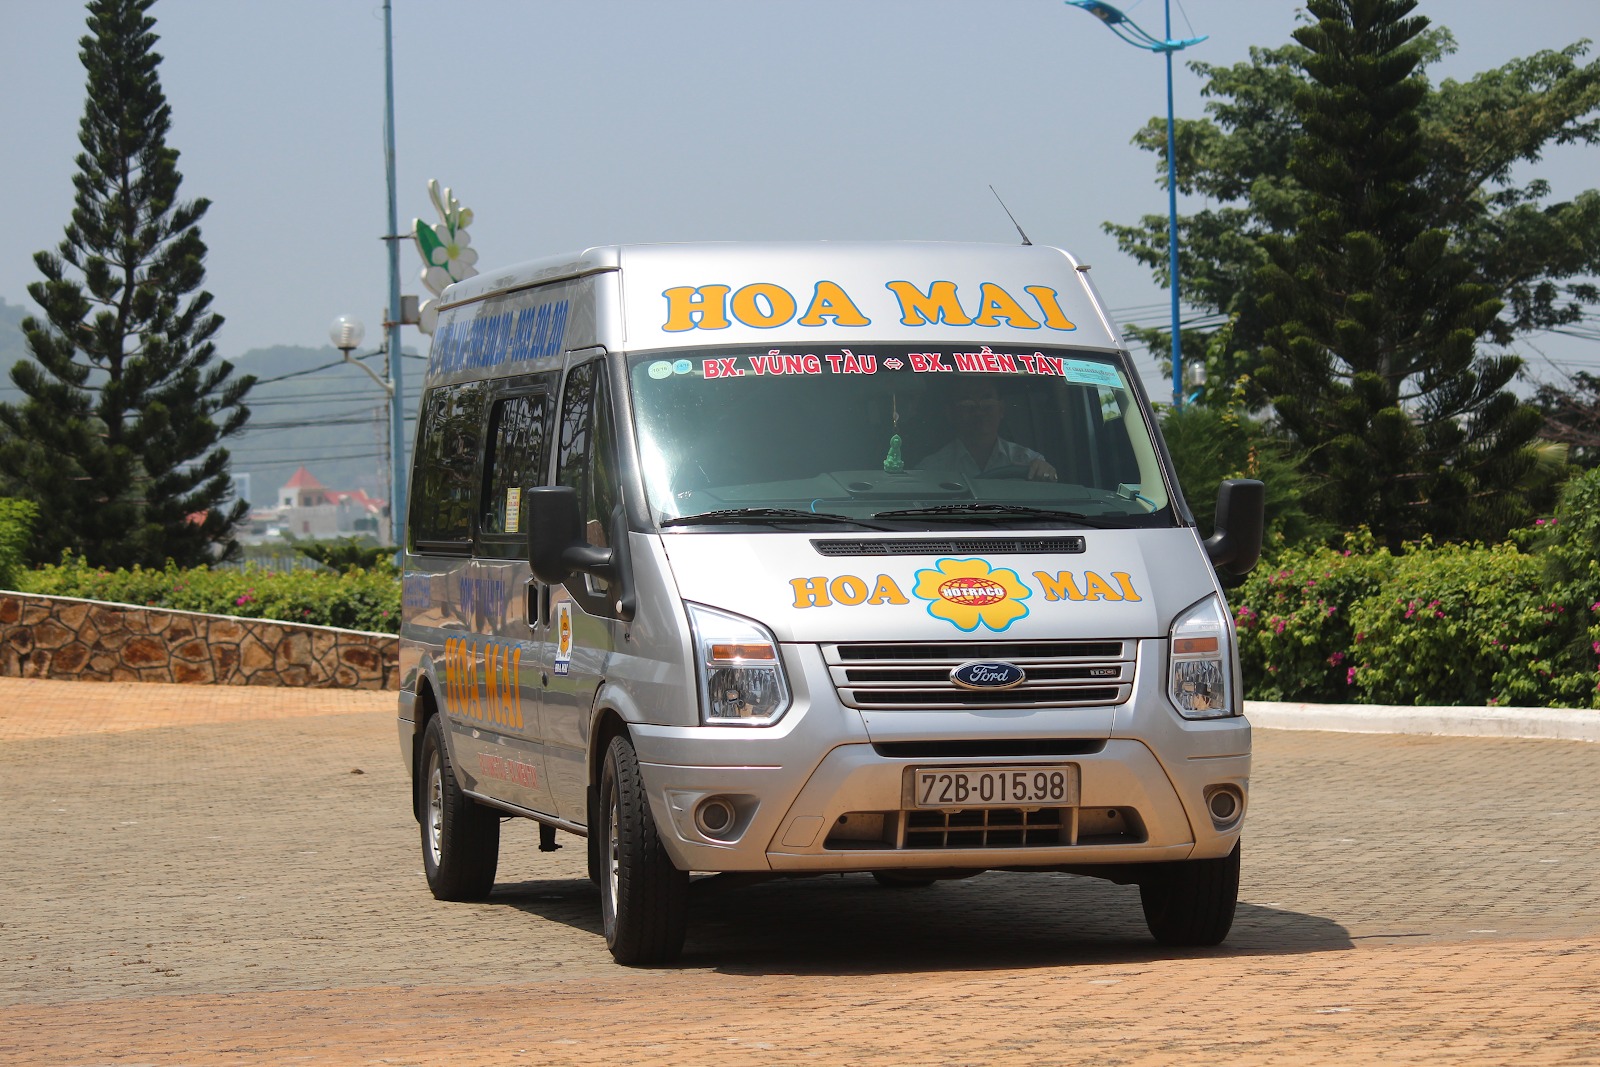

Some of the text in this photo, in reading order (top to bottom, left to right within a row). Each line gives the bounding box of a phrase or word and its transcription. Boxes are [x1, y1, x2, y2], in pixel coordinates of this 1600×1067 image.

[661, 280, 1077, 332] HOA MAI
[702, 358, 745, 379] BX.
[748, 349, 821, 378] VŨNG
[825, 350, 878, 376] TÀU
[910, 352, 952, 375] BX.
[957, 345, 1017, 376] MIỀN
[1019, 350, 1067, 379] TÂY
[788, 570, 1143, 608] HOA HOTRACO MAI
[444, 634, 525, 733] HOA MAI
[969, 663, 1009, 683] Ford
[922, 772, 1065, 803] 72B-015.98
